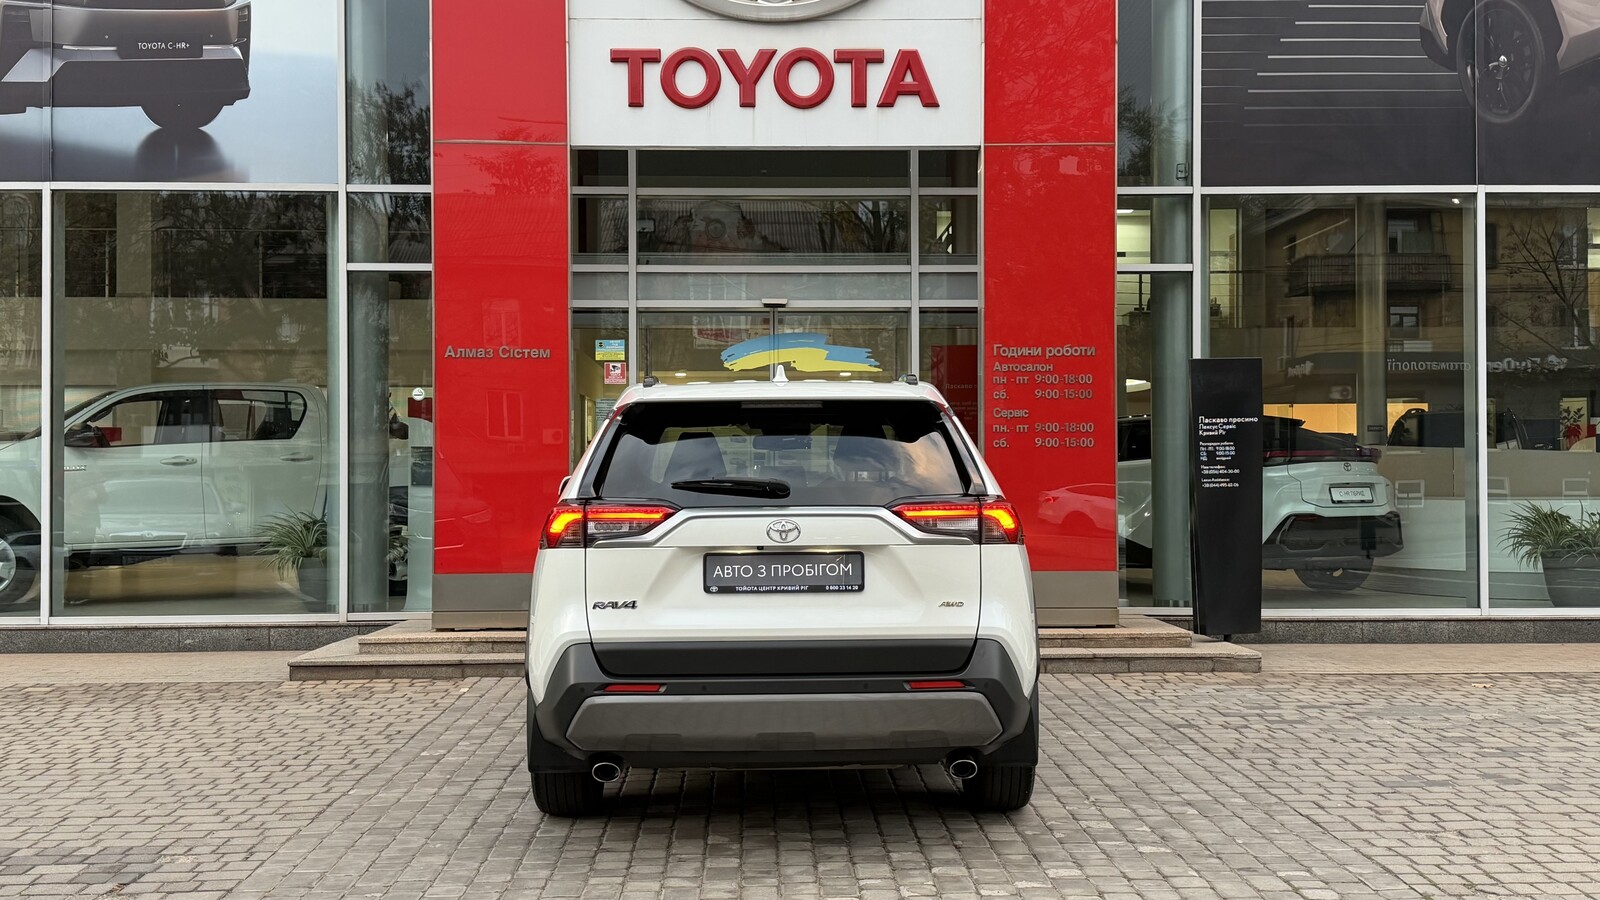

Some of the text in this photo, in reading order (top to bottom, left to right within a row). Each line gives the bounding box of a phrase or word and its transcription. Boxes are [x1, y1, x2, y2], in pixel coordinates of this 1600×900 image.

[610, 47, 940, 109] TOYOTA
[444, 345, 551, 358] Алмаз Сістем
[993, 344, 1096, 359] Години роботи
[993, 362, 1054, 372] Автосалон
[993, 389, 1009, 399] сб.
[993, 408, 1029, 419] Сервіс
[993, 437, 1009, 448] сб.
[713, 565, 753, 578] АВТО
[771, 563, 852, 577] ПРОБІГОМ
[592, 598, 638, 610] RAV4
[938, 598, 965, 608] AWD
